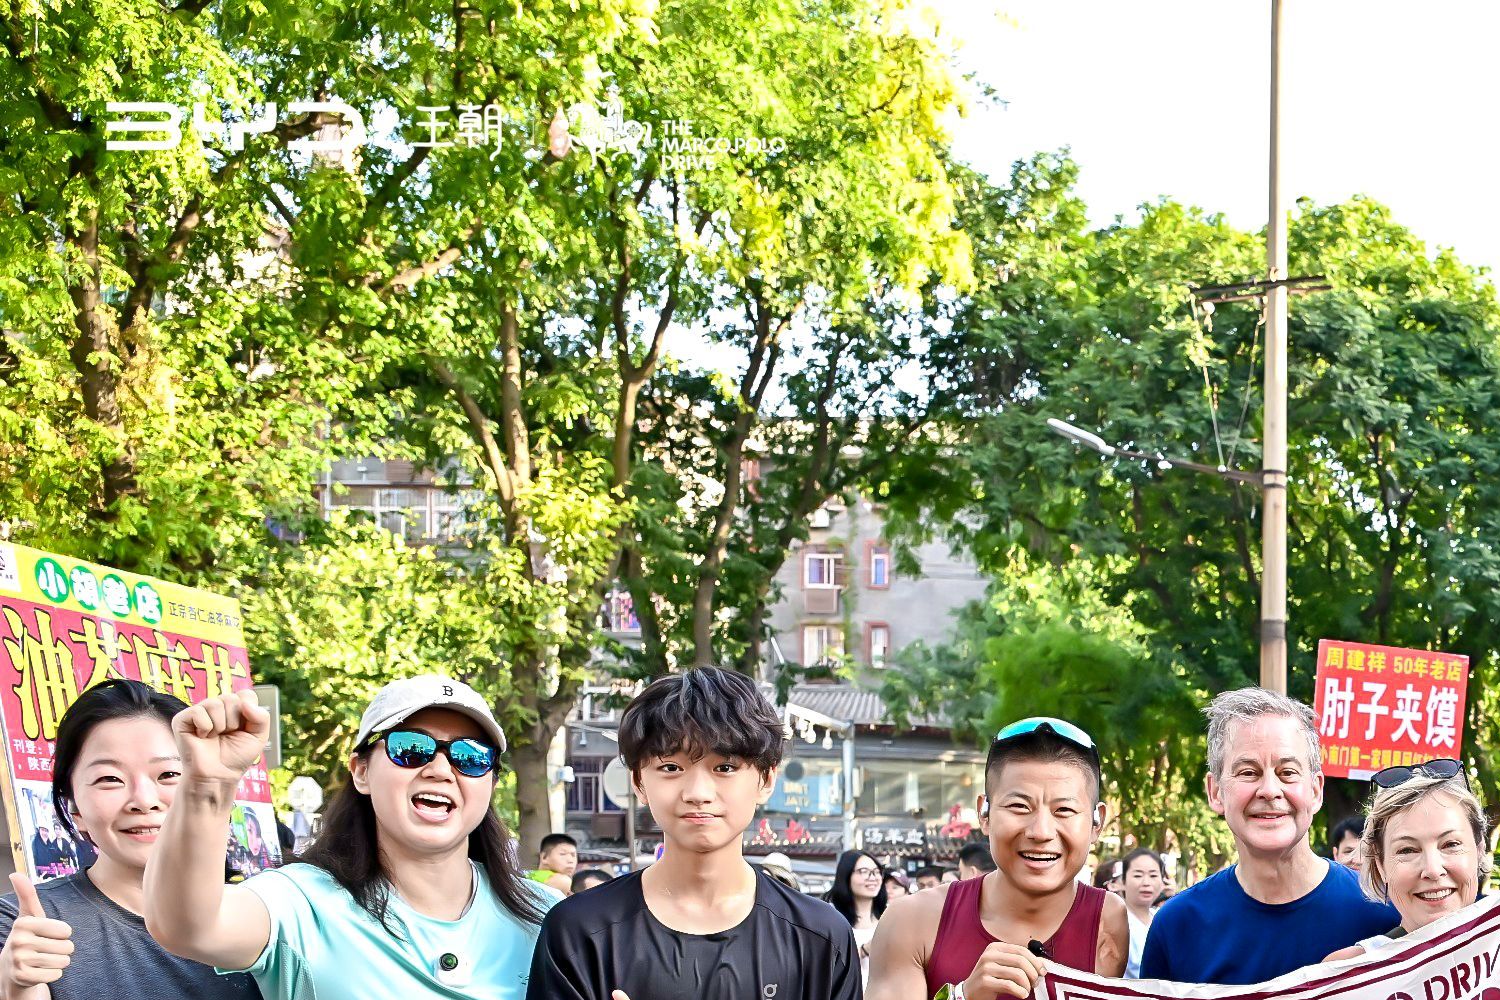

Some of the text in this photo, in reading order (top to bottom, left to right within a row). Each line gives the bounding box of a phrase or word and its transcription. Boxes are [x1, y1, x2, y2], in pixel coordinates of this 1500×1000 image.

[1325, 646, 1463, 682] 周建祥 50年老店
[442, 685, 454, 697] B
[1319, 677, 1459, 749] 肘子夹馍
